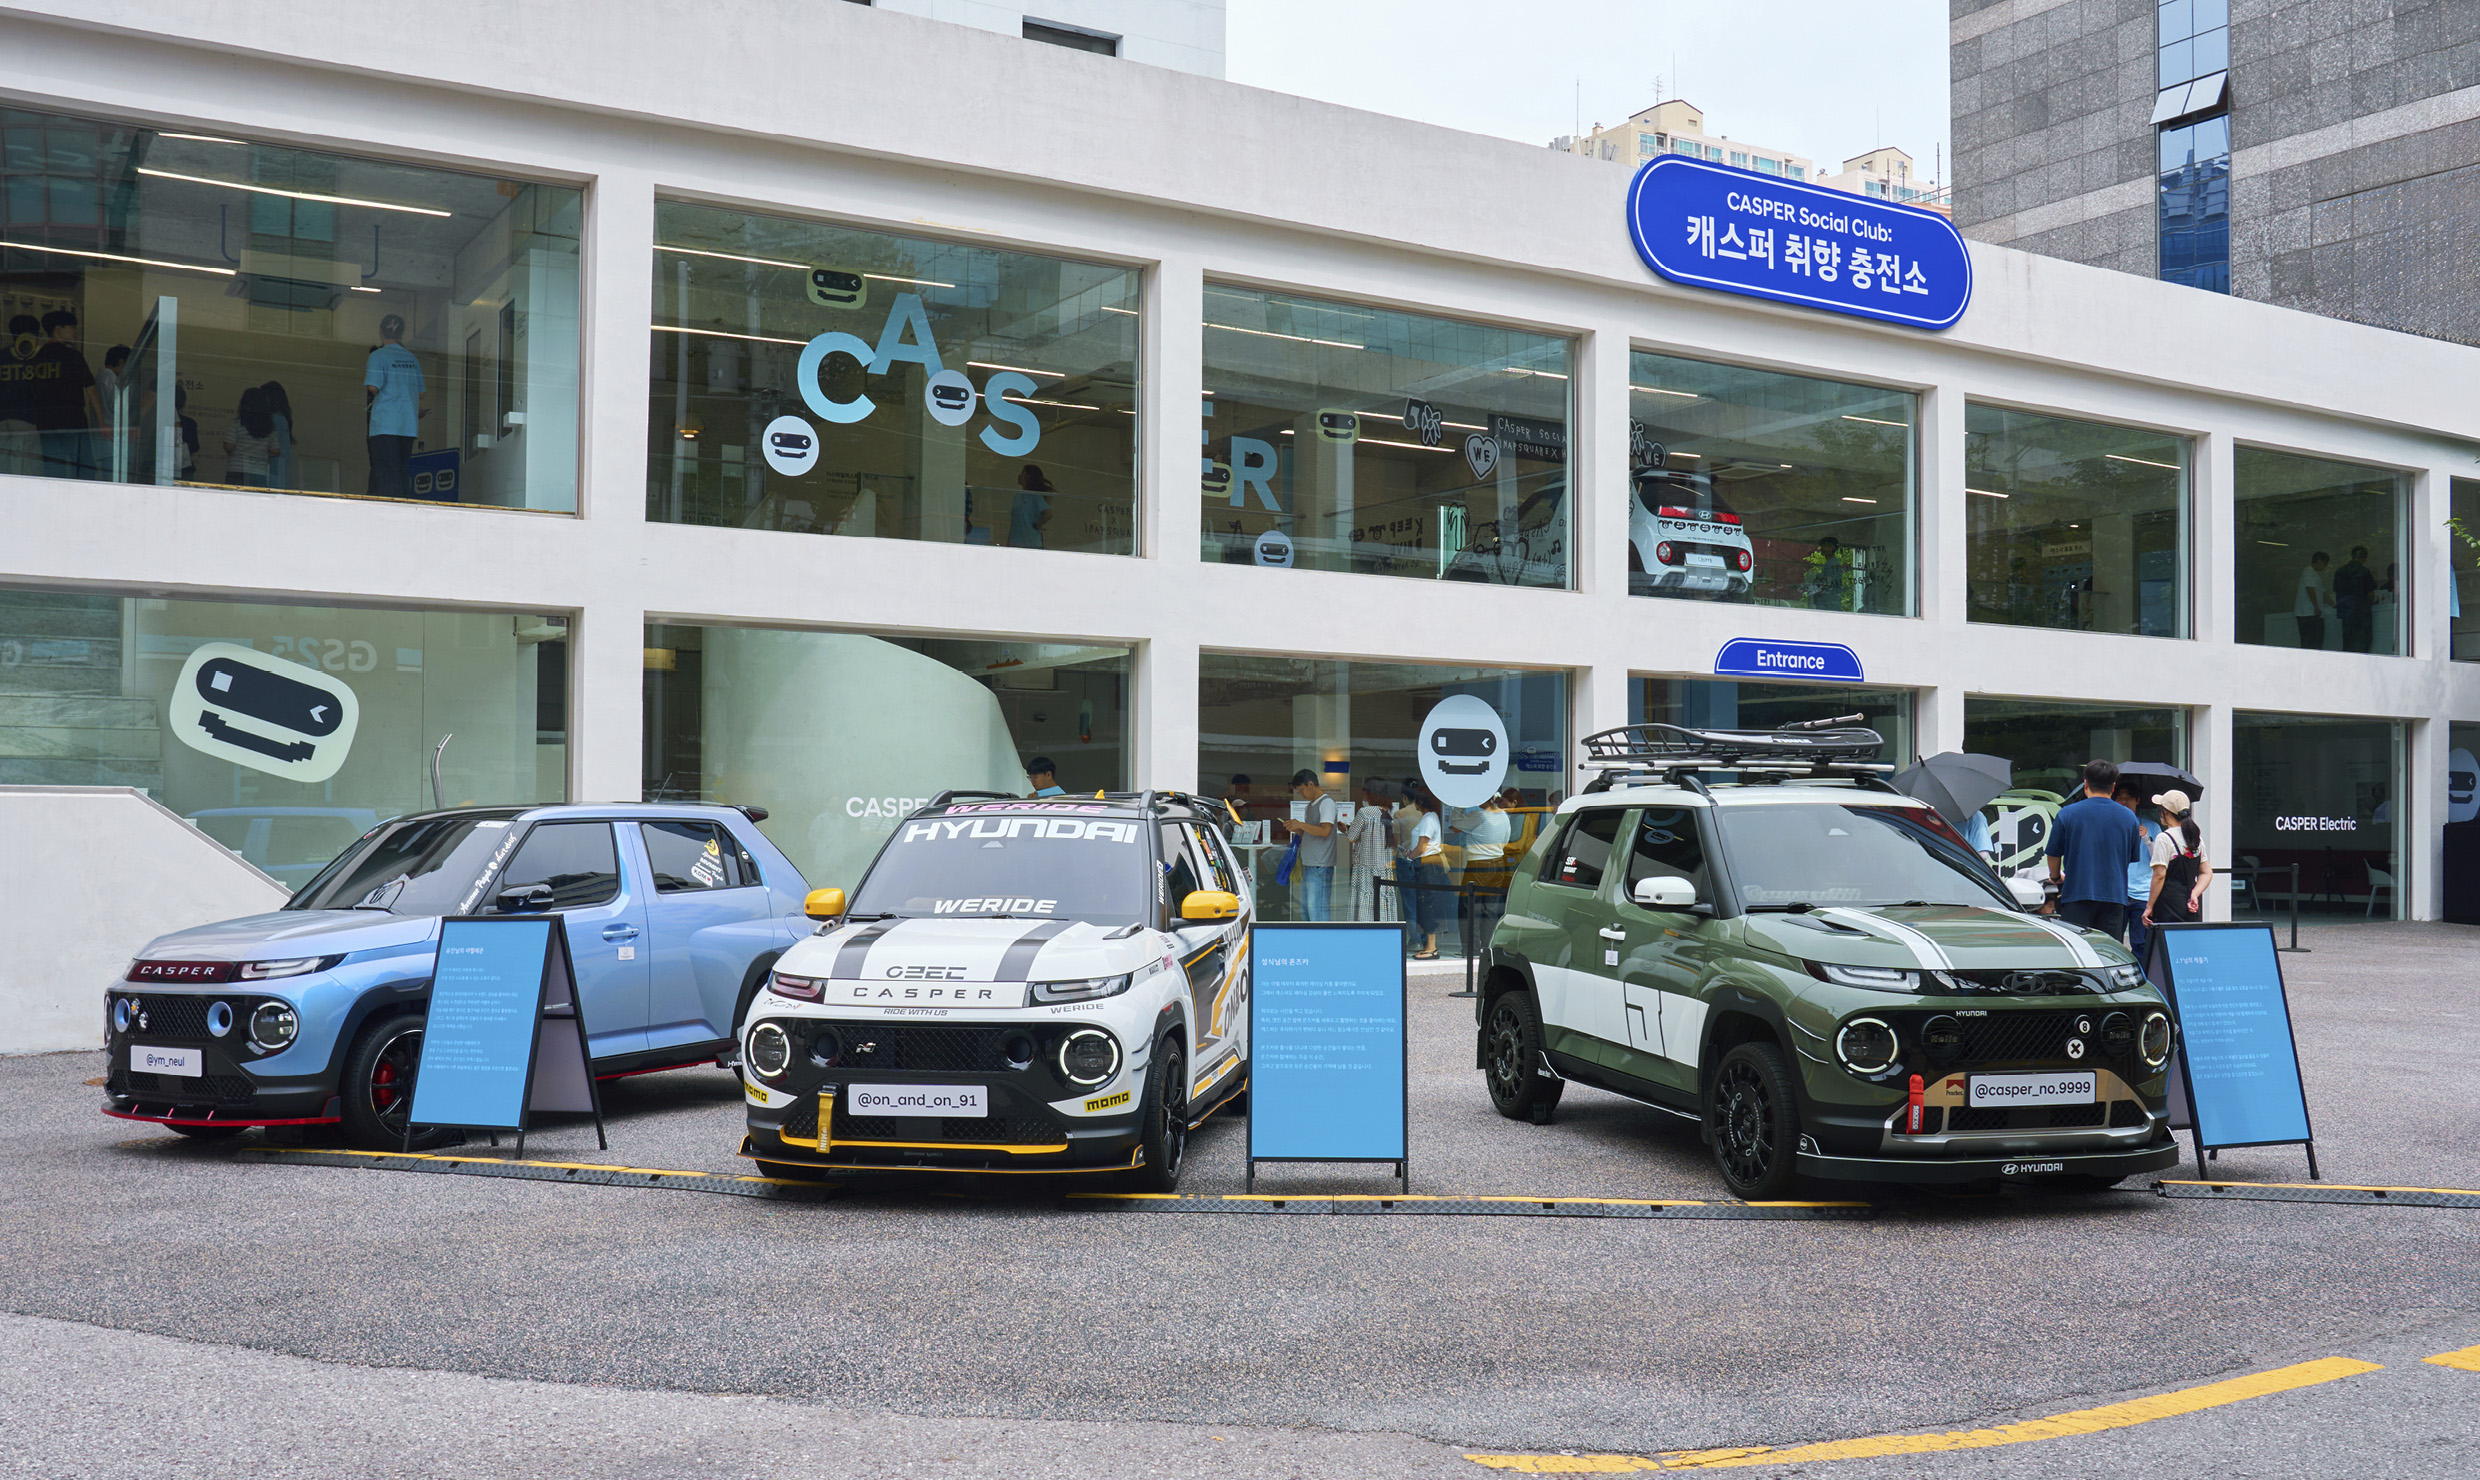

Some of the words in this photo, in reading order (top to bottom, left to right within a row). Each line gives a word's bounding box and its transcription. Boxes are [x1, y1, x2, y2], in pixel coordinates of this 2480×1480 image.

[1727, 191, 1796, 223] CASPER
[1799, 206, 1848, 234] Social
[1852, 219, 1893, 243] Club:
[1687, 215, 1774, 269] 캐스퍼
[1784, 232, 1841, 282] 취향
[1848, 247, 1929, 295] 충전소
[1473, 446, 1491, 463] WE
[1097, 504, 1132, 517] CASPER
[1757, 649, 1825, 669] Entrance
[945, 803, 1108, 815] WERIDE
[904, 818, 1138, 844] HYUNDAI
[2275, 816, 2318, 831] CASPER
[2319, 816, 2357, 831] Electric
[934, 898, 1058, 914] WERIDE
[1261, 958, 1288, 966] 성식님의
[1289, 958, 1309, 966] 온즈카
[140, 965, 216, 976] CASPER
[853, 987, 993, 1000] CASPER
[908, 1008, 933, 1016] WITH
[1050, 1003, 1105, 1014] WERIDE
[146, 1053, 185, 1068] @ym_neul
[1975, 1081, 2091, 1099] @casper_no.9999
[858, 1092, 978, 1108] @on_and_on_91
[1087, 1092, 1130, 1111] momo
[2020, 1162, 2063, 1173] HYUNDAI
